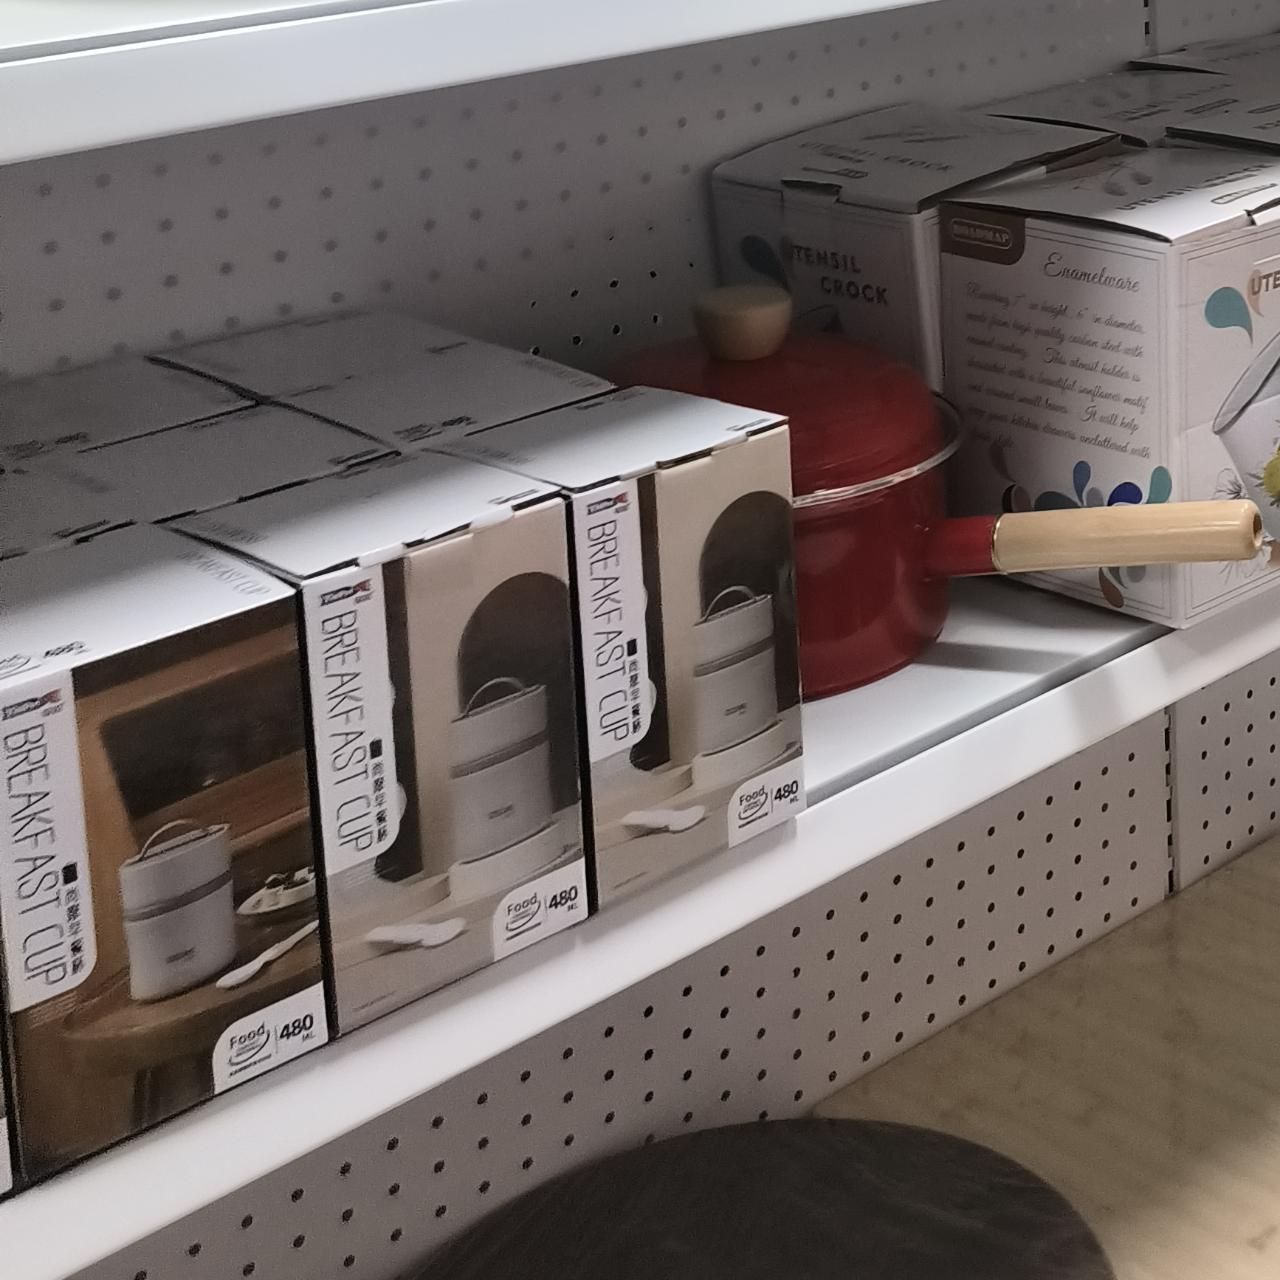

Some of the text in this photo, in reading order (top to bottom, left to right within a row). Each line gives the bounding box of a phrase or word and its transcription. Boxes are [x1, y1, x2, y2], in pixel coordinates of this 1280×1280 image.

[1043, 252, 1141, 293] Enamelware
[820, 275, 889, 305] CROCK
[586, 519, 630, 743] BREAKFAST CUP
[320, 609, 369, 786] BREAKFAST
[738, 784, 766, 807] Food
[773, 779, 799, 802] 480
[2, 722, 61, 917] BREAKFAST
[335, 794, 374, 853] CUP
[506, 891, 538, 917] Food
[548, 885, 579, 911] 480
[22, 923, 68, 986] CUP
[228, 1021, 265, 1051] Food
[279, 1013, 314, 1041] 480
